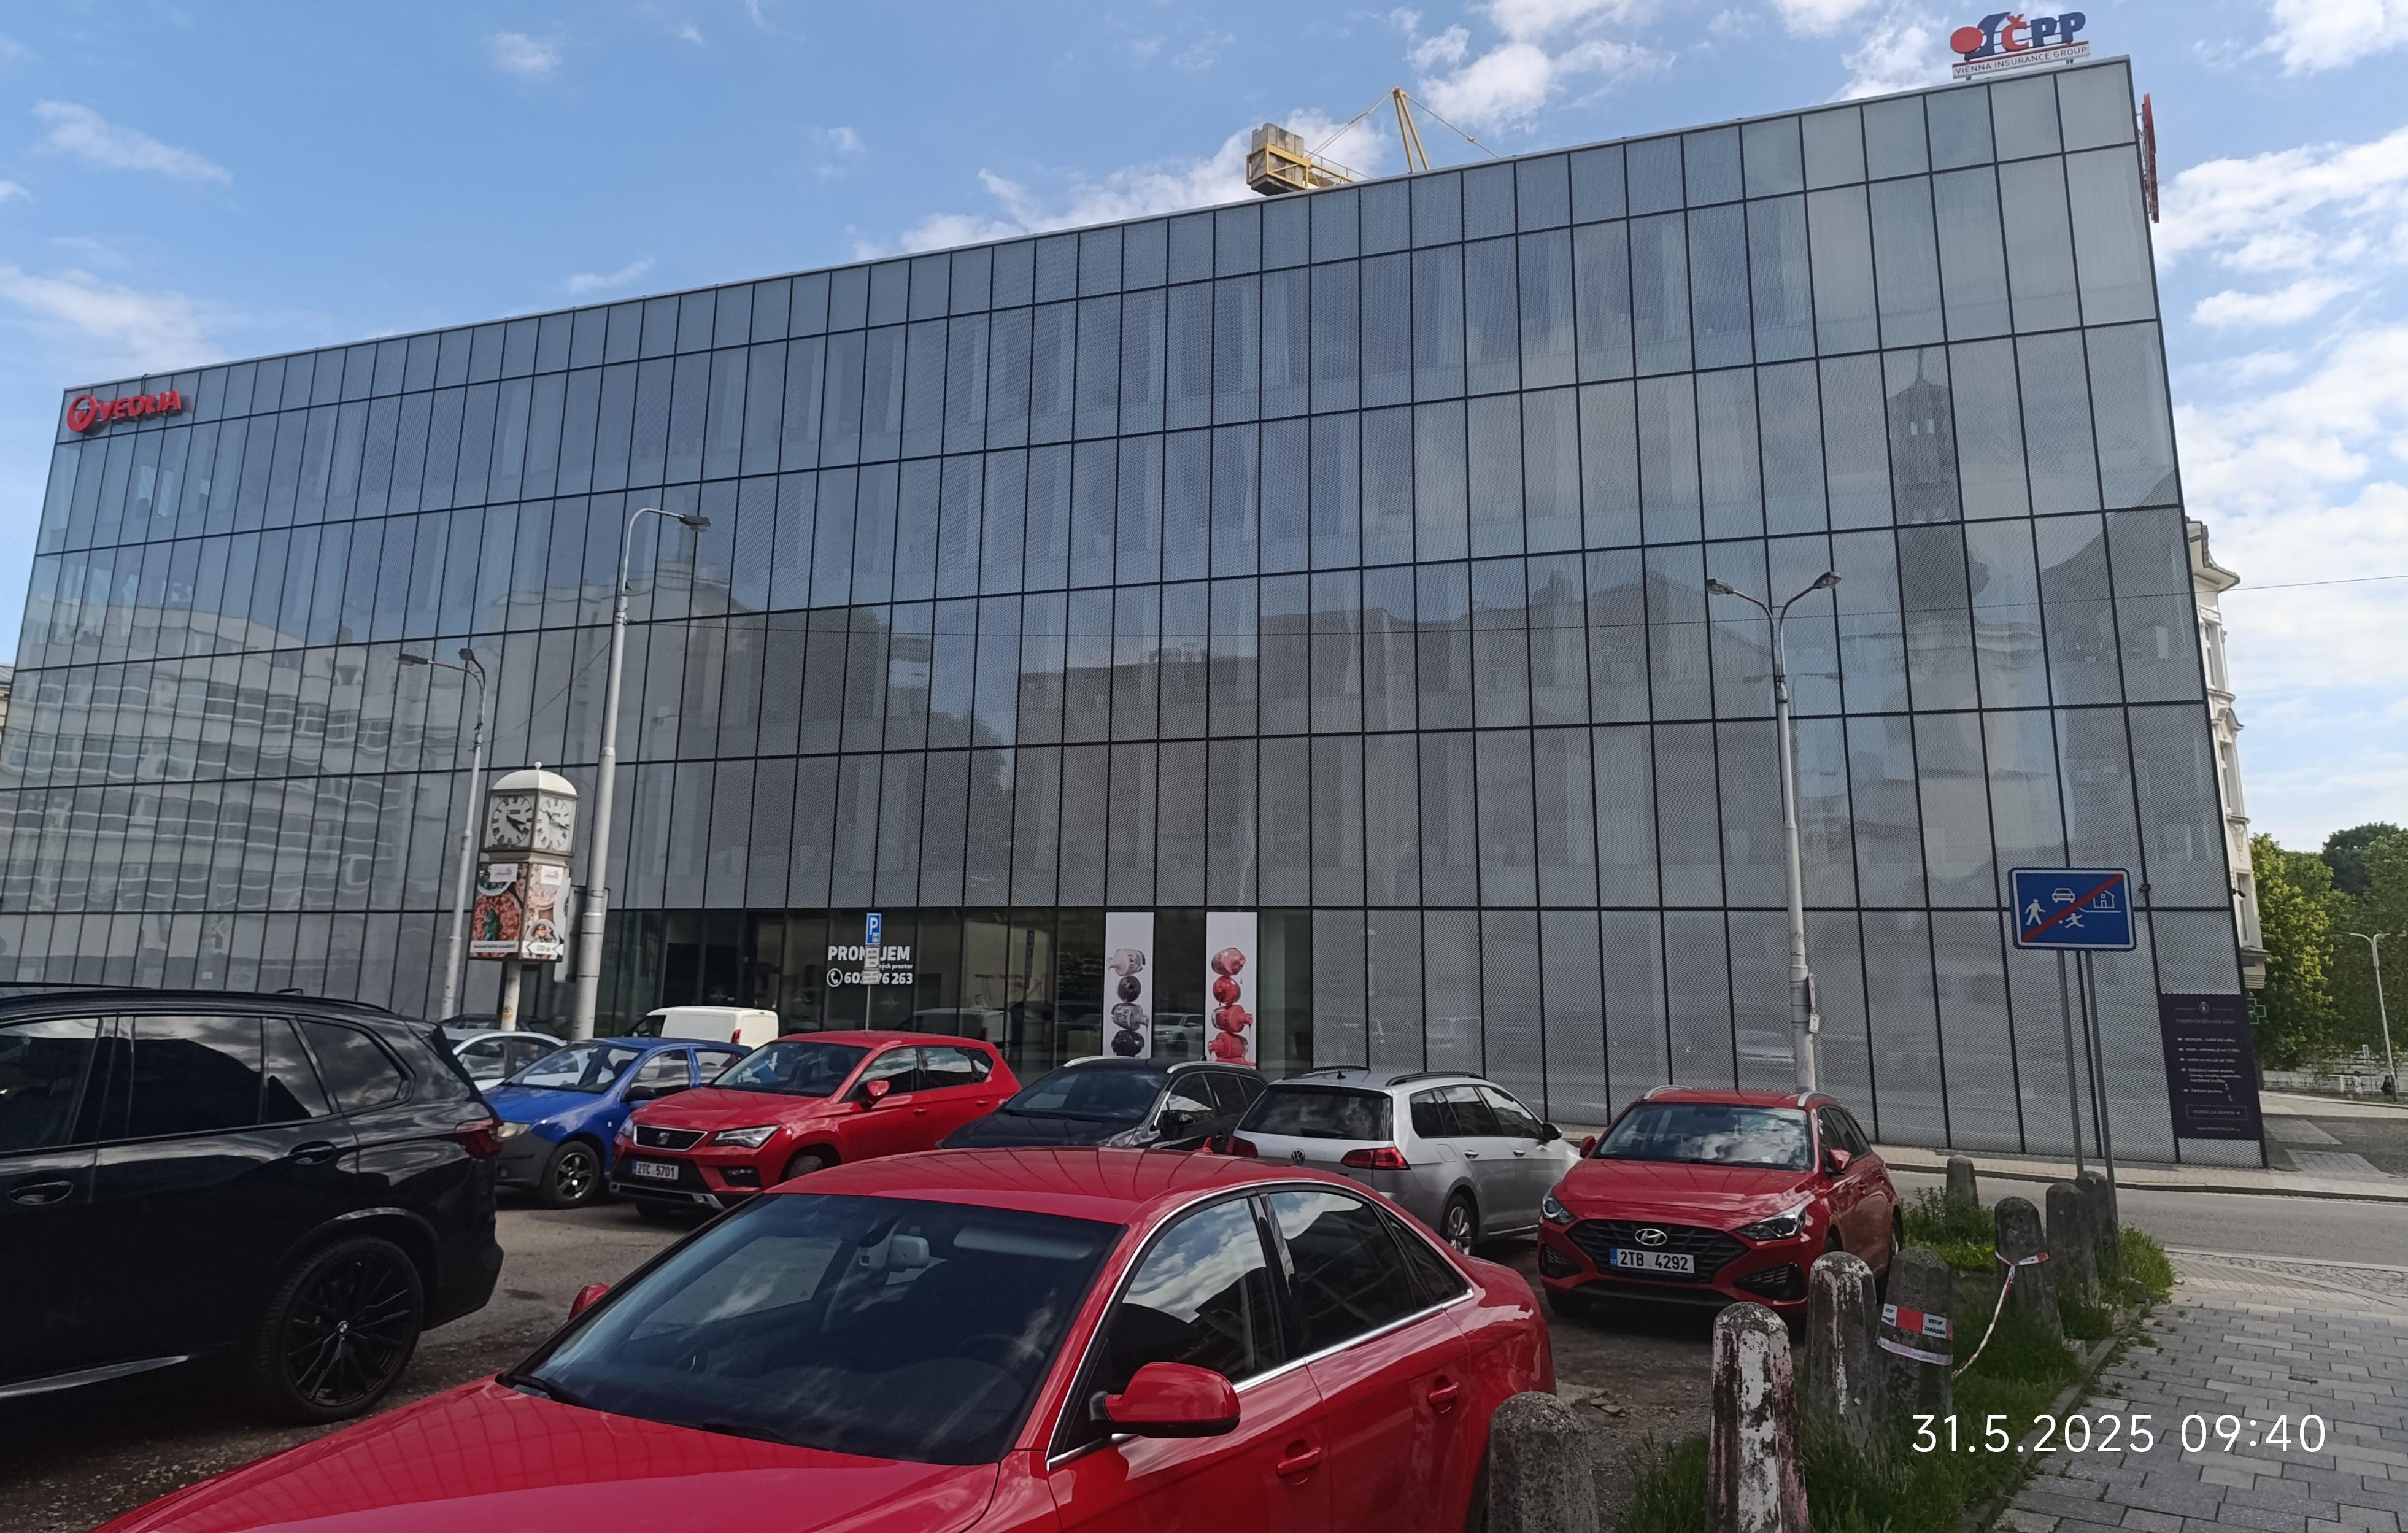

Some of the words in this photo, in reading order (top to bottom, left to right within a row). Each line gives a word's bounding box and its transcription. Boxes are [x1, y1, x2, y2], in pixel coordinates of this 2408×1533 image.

[2001, 12, 2086, 51] ČPP
[1955, 62, 1992, 75] VIENNA
[1994, 52, 2051, 68] INSURANCE
[2053, 45, 2088, 59] GROUP
[99, 390, 182, 420] VEOLIA
[869, 917, 878, 935] P
[828, 946, 911, 961] PRONJEM
[891, 972, 913, 984] 263
[638, 1163, 651, 1175] 2TC
[656, 1165, 675, 1178] 5701
[1620, 1251, 1644, 1266] 2TB
[1655, 1254, 1688, 1271] 4292
